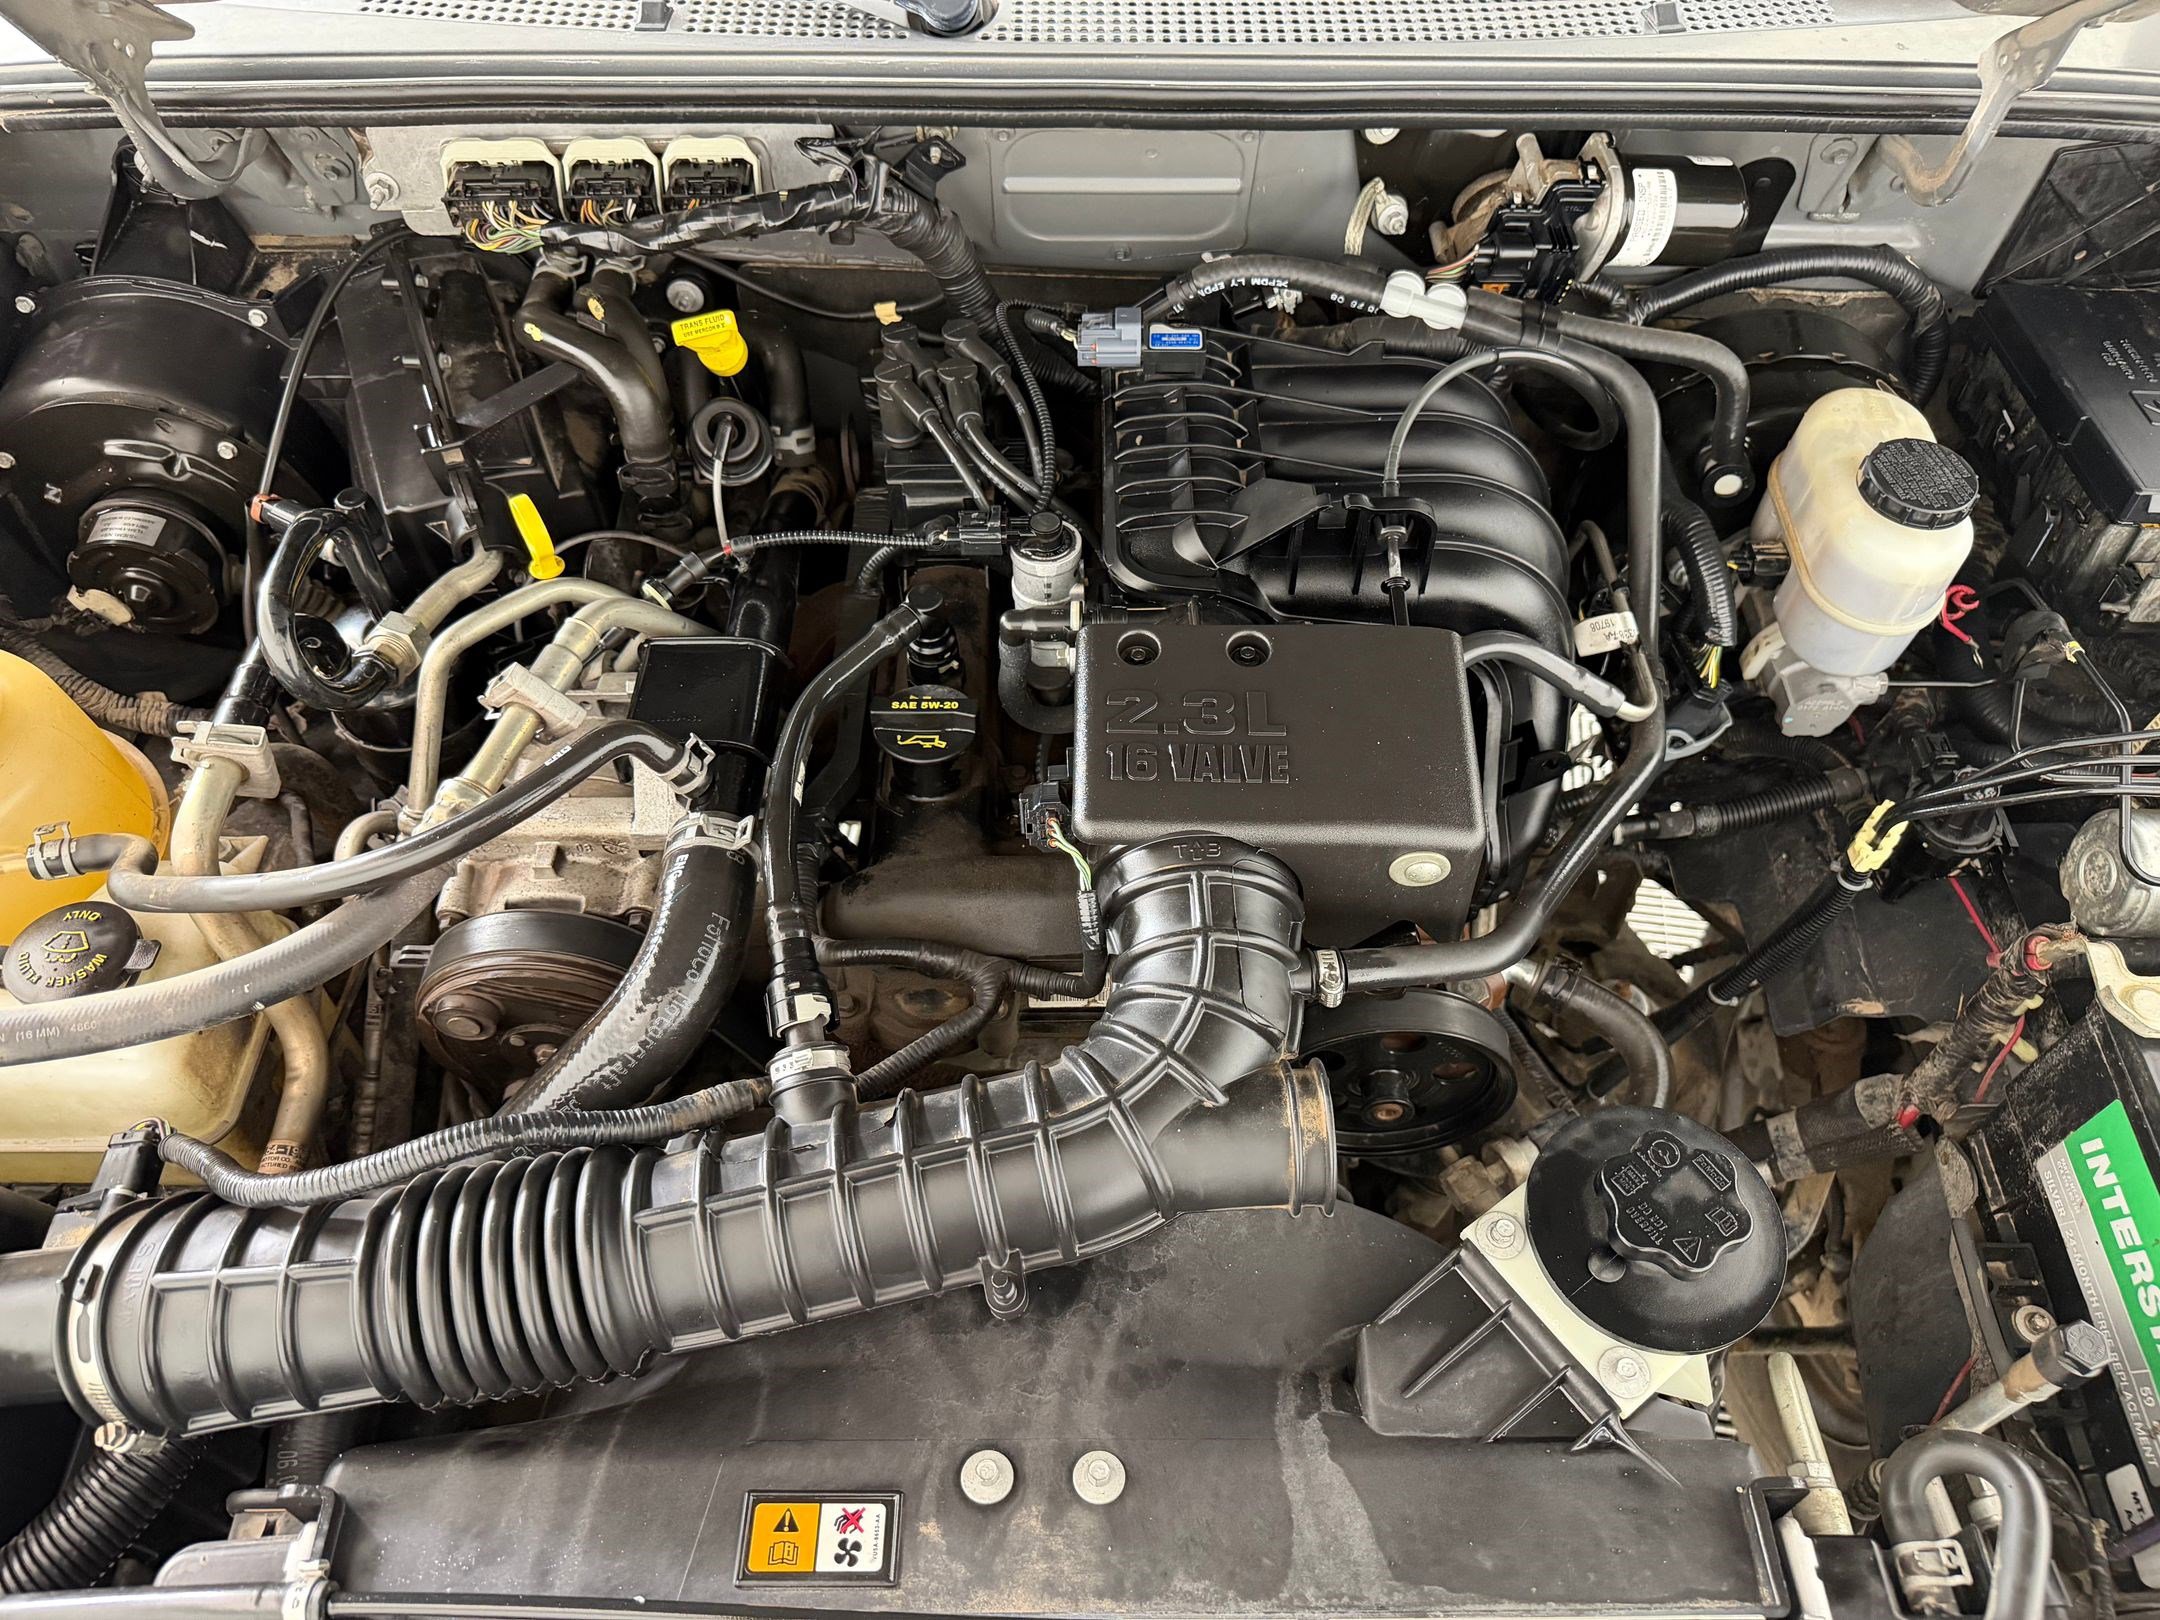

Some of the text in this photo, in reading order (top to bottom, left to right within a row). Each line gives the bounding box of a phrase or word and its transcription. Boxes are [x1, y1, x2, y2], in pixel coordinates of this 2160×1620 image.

[679, 314, 725, 331] TRANS FLUID
[891, 701, 959, 709] SAE 5W-20
[1105, 689, 1288, 737] 2.3L
[1105, 743, 1290, 784] 16 VALVE
[63, 910, 101, 921] ONLY
[18, 951, 108, 988] WASHER FLUID
[15, 1030, 33, 1043] (16
[36, 1026, 60, 1040] MM)
[1694, 1155, 1728, 1188] FoMoCo
[1625, 1206, 1666, 1246] OVERFILL
[1650, 1213, 1669, 1232] NOT
[2080, 1137, 2160, 1354] INTERS
[2044, 1170, 2067, 1218] SILVER
[2064, 1229, 2098, 1309] 24-MONTH
[2109, 1354, 2160, 1468] REPLACEMENT
